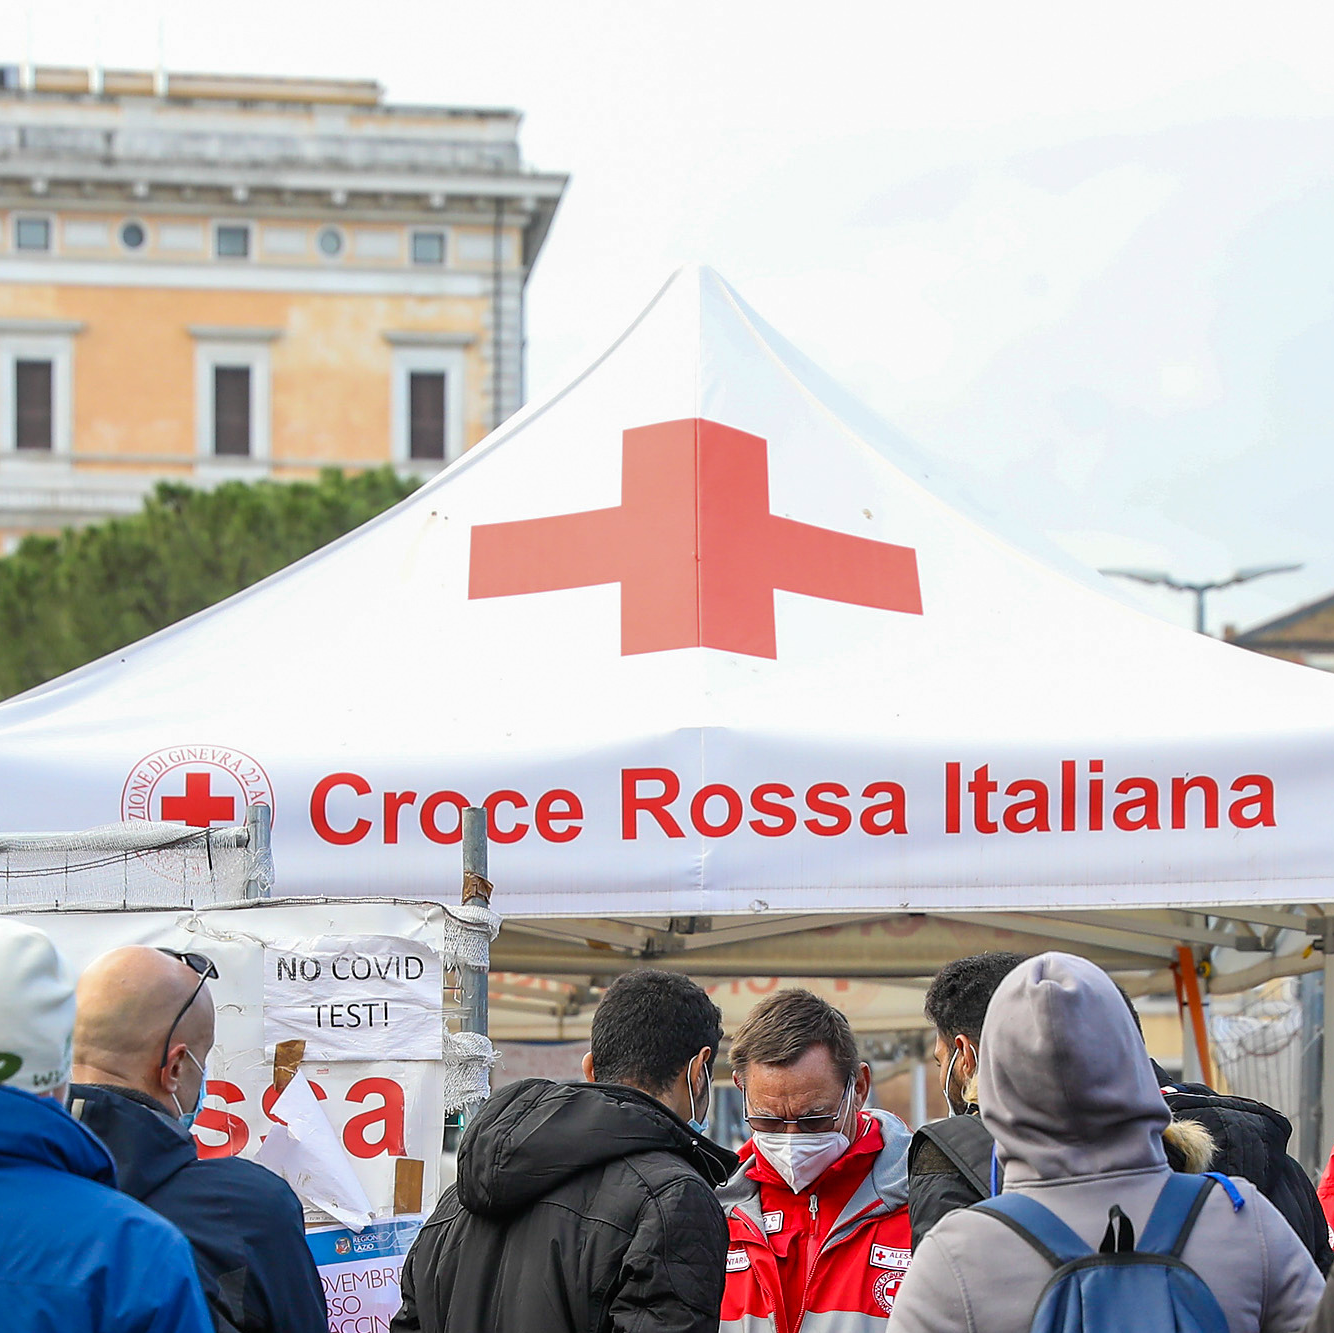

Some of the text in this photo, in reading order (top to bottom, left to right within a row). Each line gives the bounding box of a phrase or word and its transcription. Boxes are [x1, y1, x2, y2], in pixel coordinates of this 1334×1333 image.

[147, 755, 168, 775] DI
[168, 748, 243, 772] GINEVRA
[240, 767, 261, 787] 22
[311, 759, 1277, 845] Croce Rossa Italiana
[277, 955, 424, 981] NO COVID
[310, 1002, 390, 1028] TEST!
[353, 1243, 374, 1251] LAZIO
[326, 1296, 361, 1318] SSO
